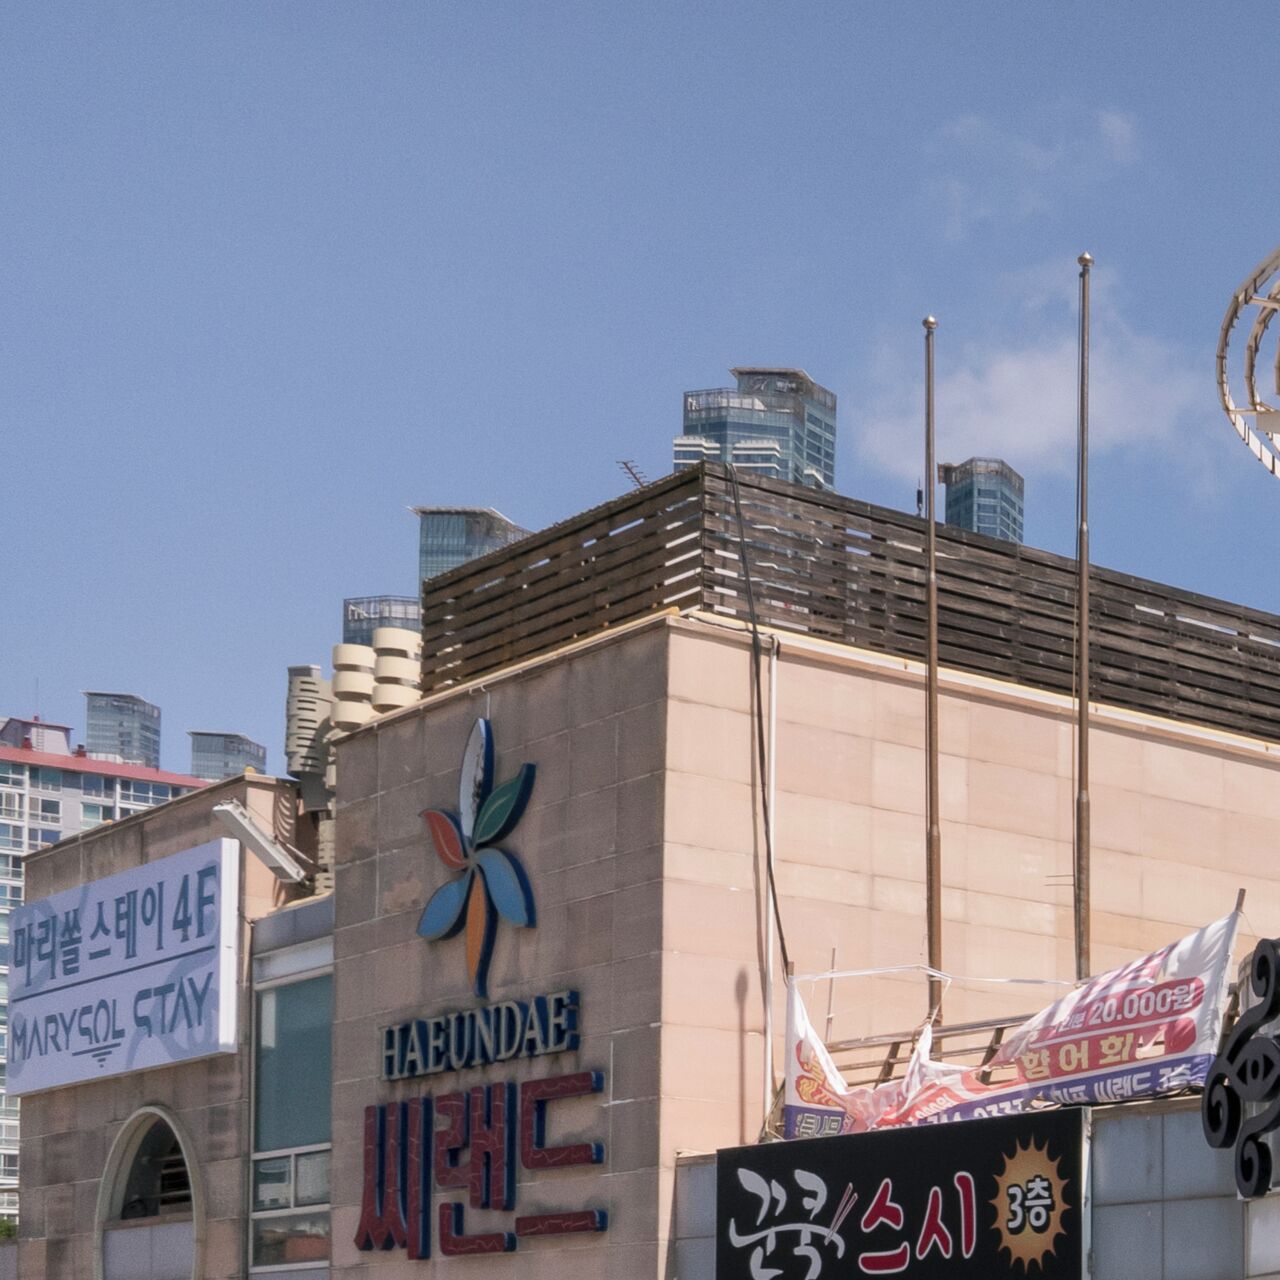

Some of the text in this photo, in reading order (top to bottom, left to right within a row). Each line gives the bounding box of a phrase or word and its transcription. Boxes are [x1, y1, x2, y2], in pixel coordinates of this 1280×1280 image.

[14, 865, 217, 987] 마리쏠 스테이 4F
[11, 971, 213, 1064] MARYSOL STAY
[380, 990, 575, 1081] HAEUNDAE
[1087, 983, 1197, 1027] 20.000원
[1094, 1071, 1153, 1103] 씨랜드
[354, 1071, 605, 1260] 씨랜드
[858, 1170, 978, 1275] 스시
[1007, 1176, 1052, 1230] 3층
